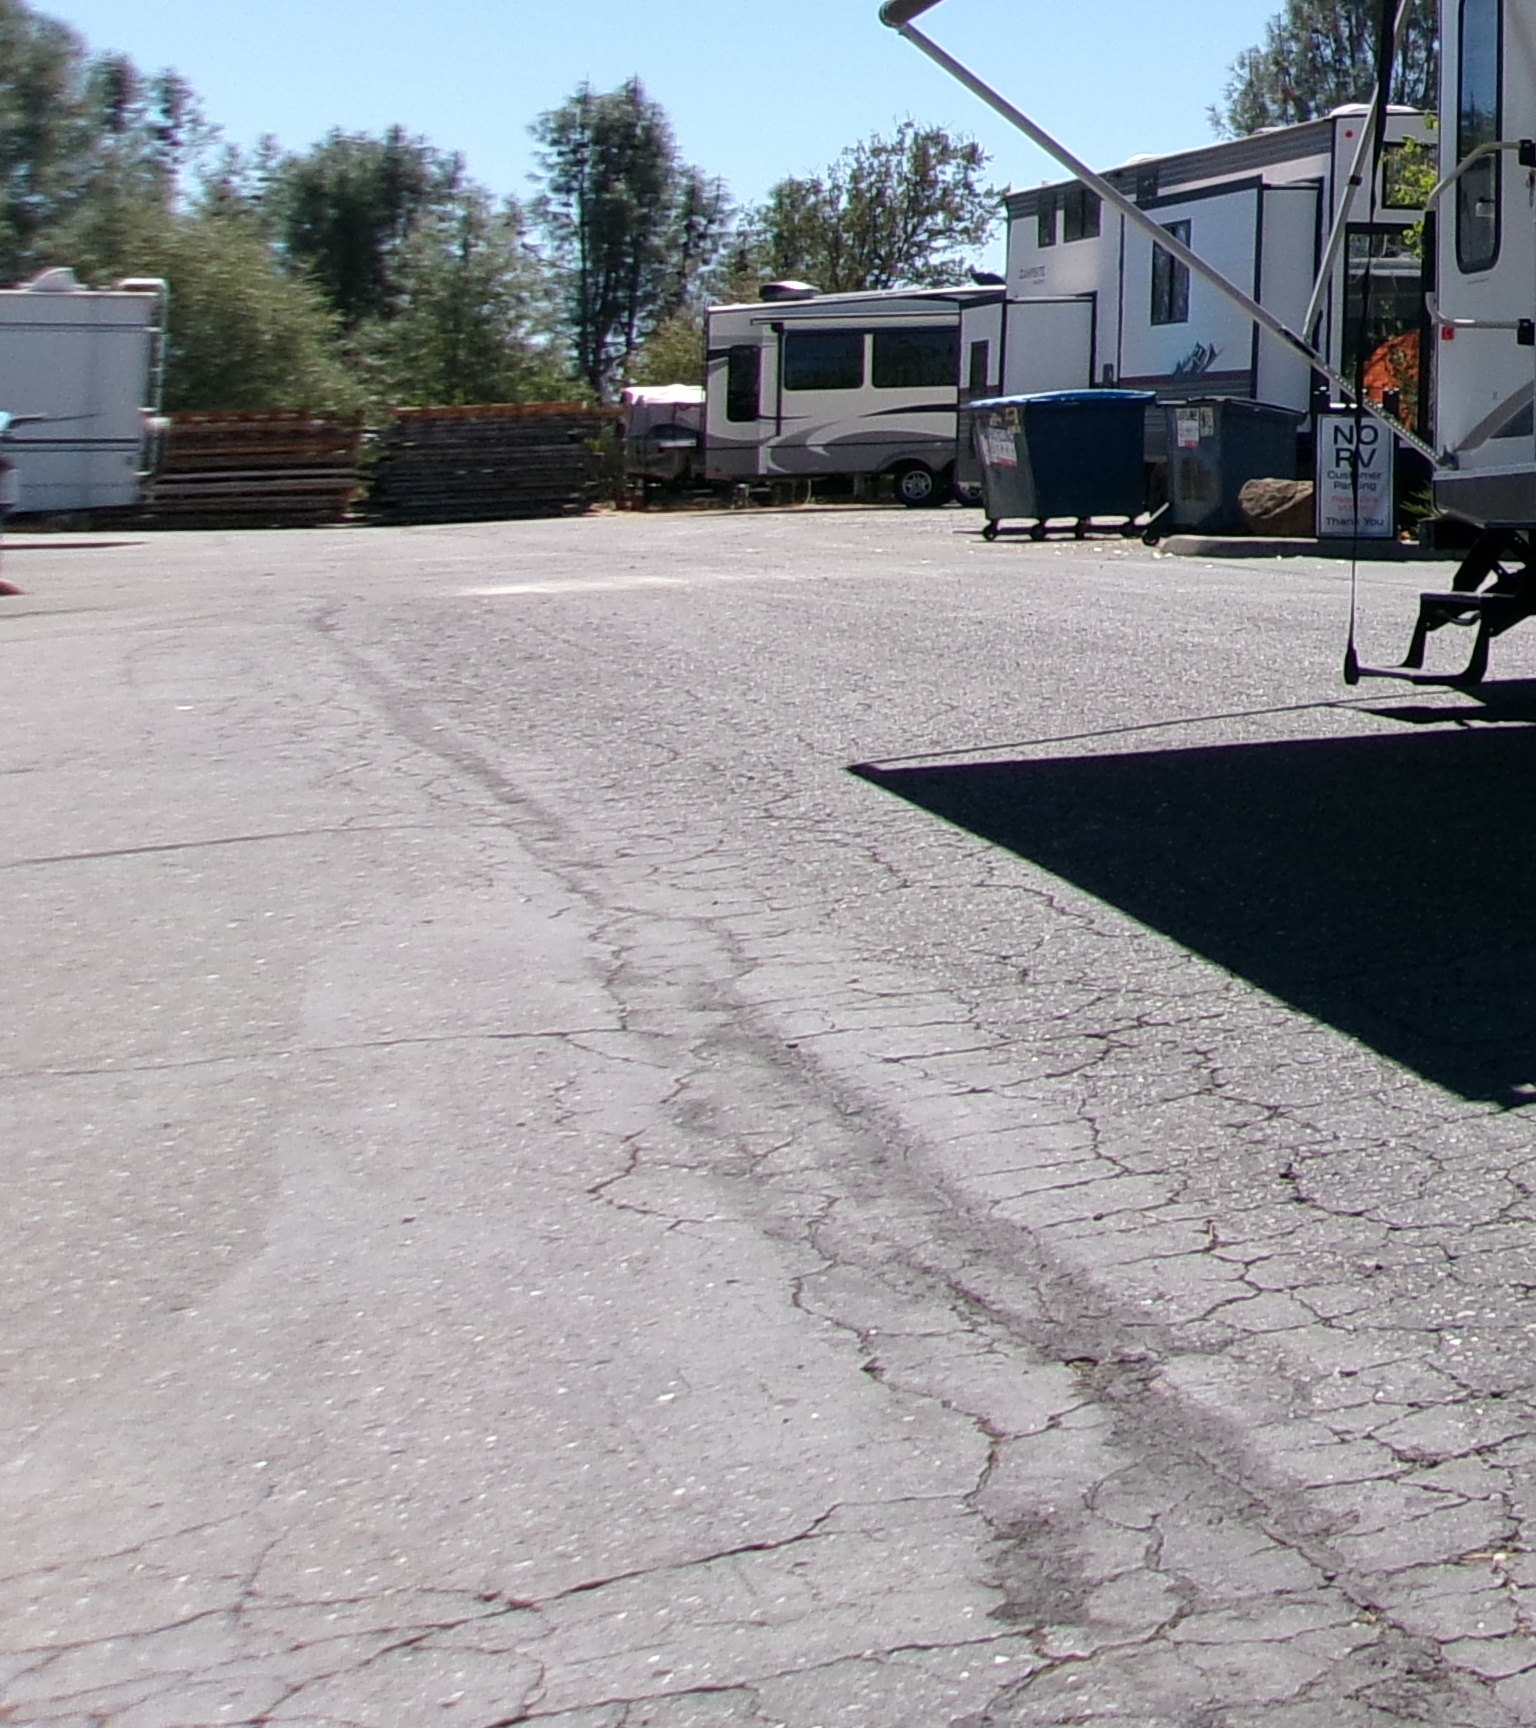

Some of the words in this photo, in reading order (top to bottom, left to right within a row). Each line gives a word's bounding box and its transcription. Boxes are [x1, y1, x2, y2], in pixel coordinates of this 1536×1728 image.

[1333, 424, 1379, 446] NO
[1335, 447, 1378, 469] RV
[1327, 470, 1382, 480] Cusmer
[1333, 480, 1377, 492] Paring
[1363, 516, 1385, 527] You
